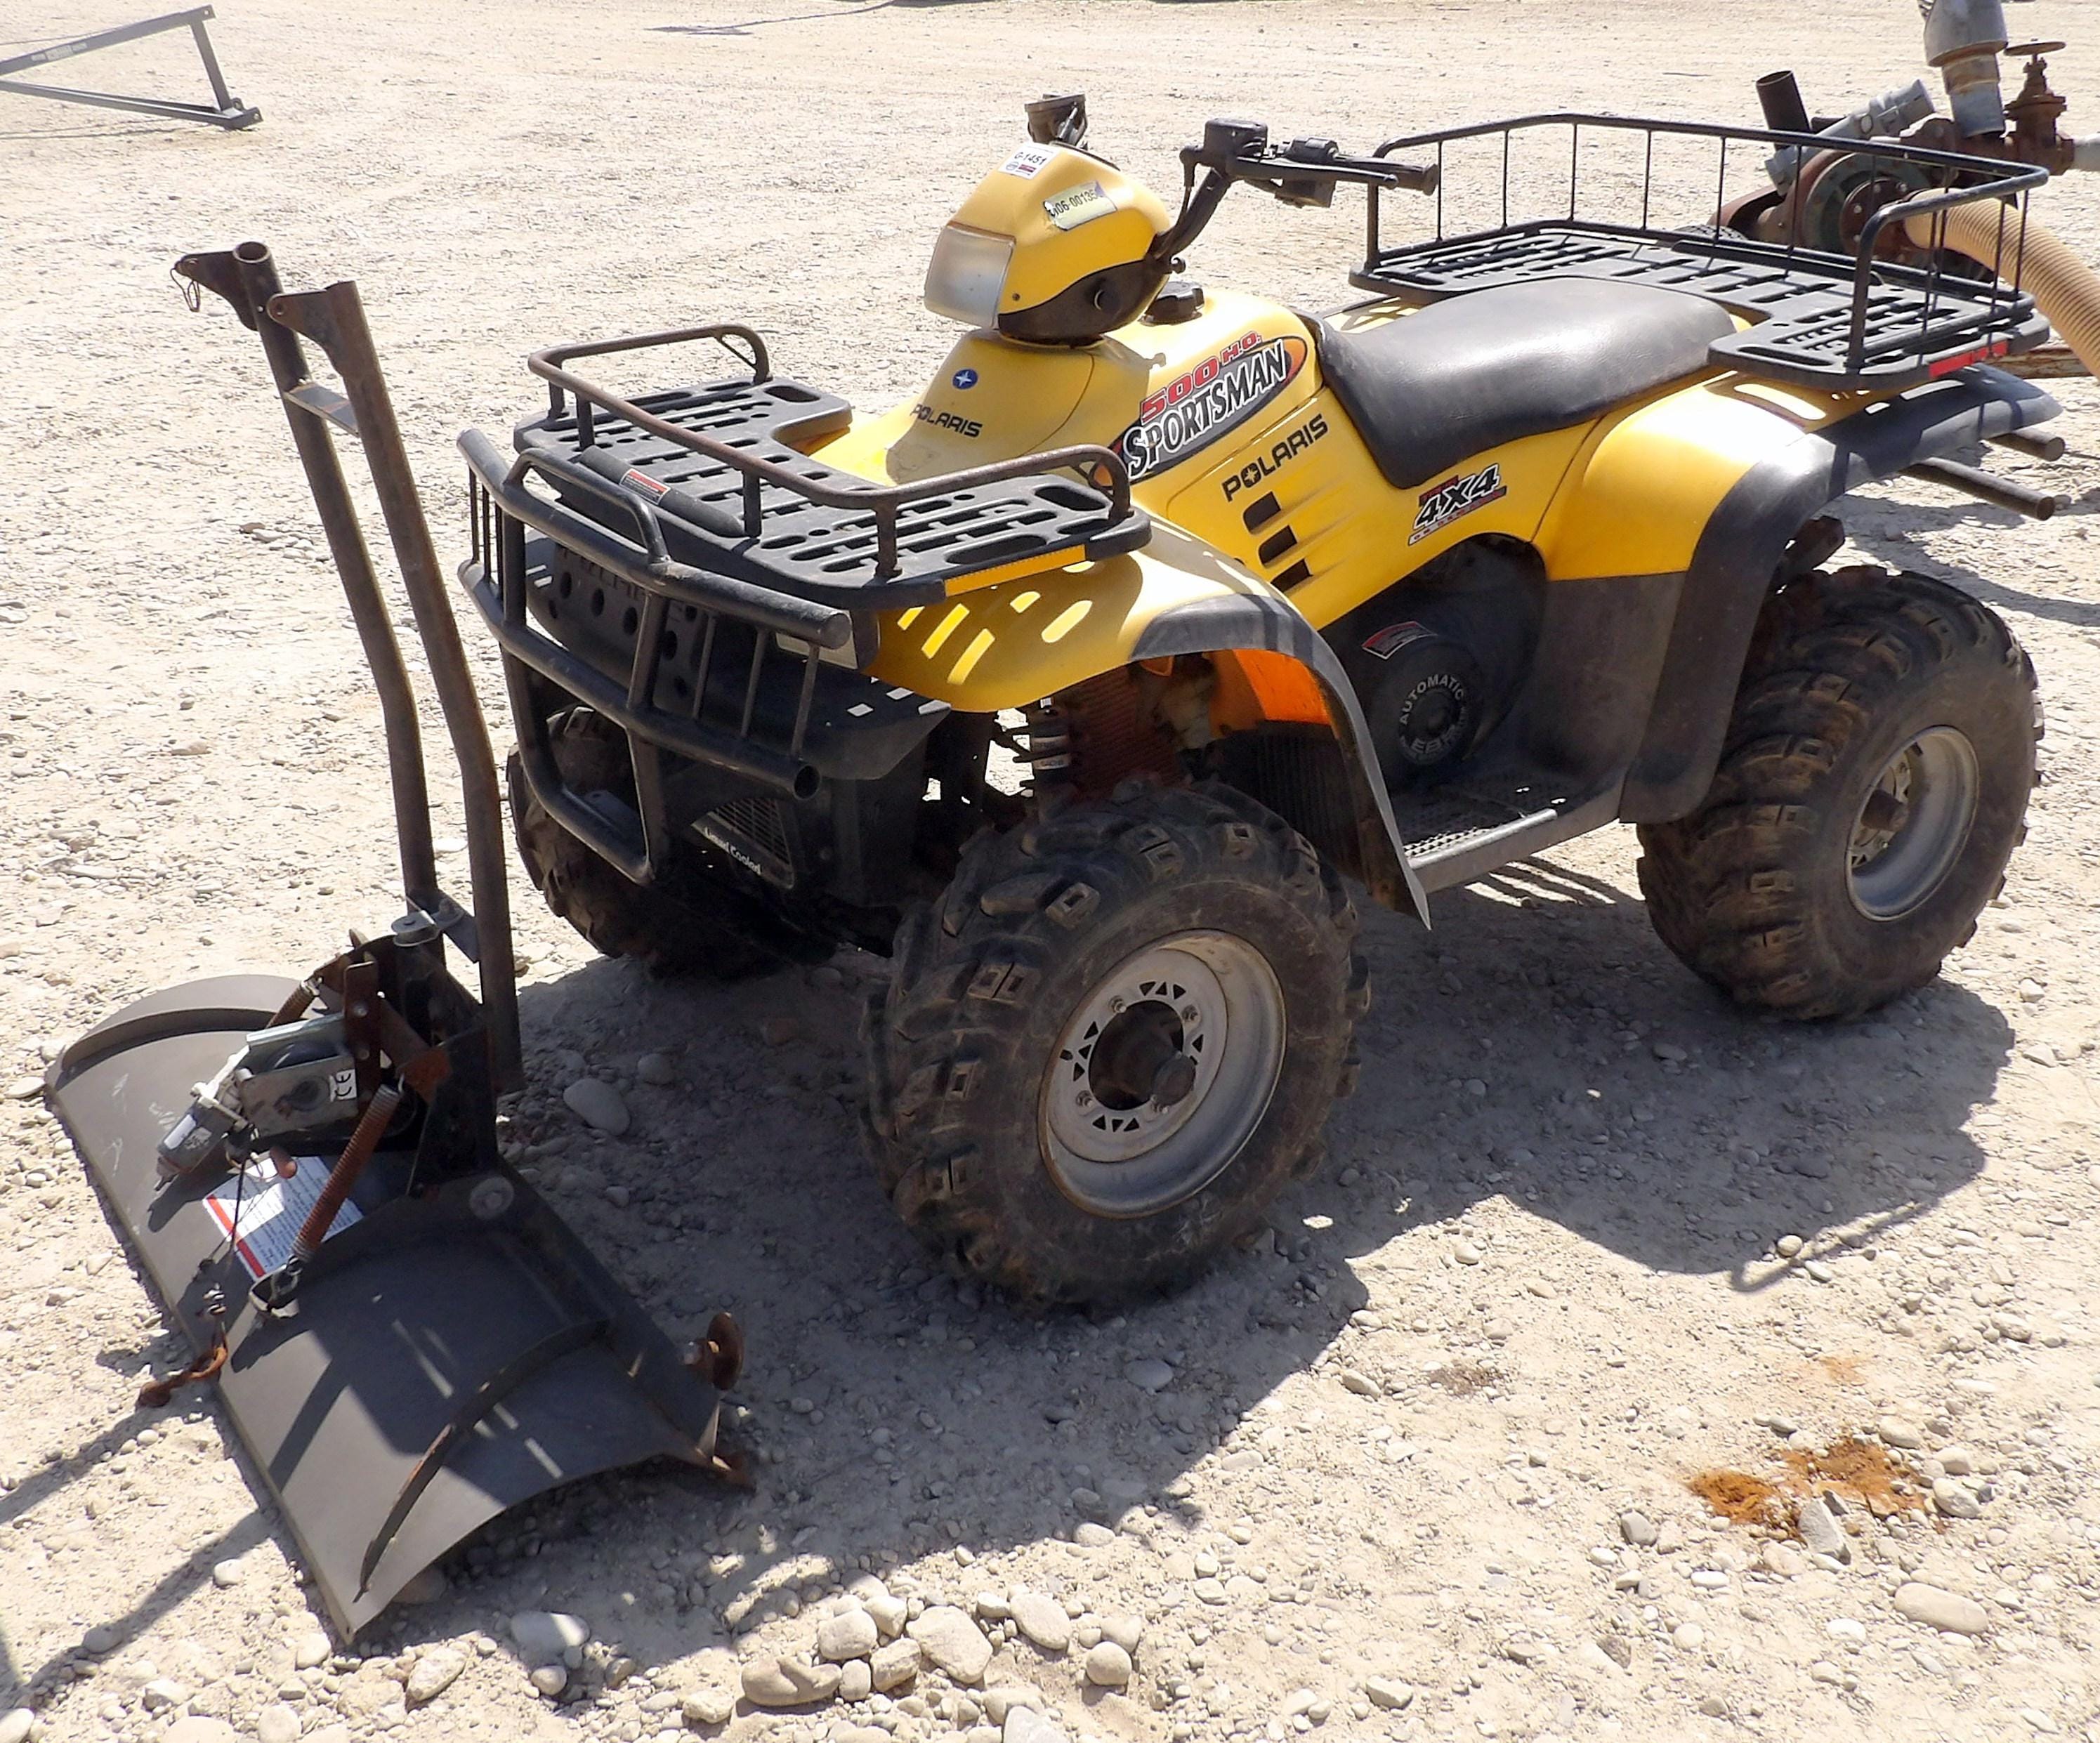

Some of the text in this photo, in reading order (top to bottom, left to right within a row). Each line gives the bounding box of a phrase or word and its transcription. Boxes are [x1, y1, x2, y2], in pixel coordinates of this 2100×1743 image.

[1124, 338, 1287, 478] SPORTSMAN
[1139, 331, 1263, 424] 500 H.O.
[910, 403, 983, 438] POLARIS
[1221, 413, 1328, 502] POLARIS
[1399, 673, 1464, 725] AUTOMATIC
[730, 846, 763, 875] Cooled
